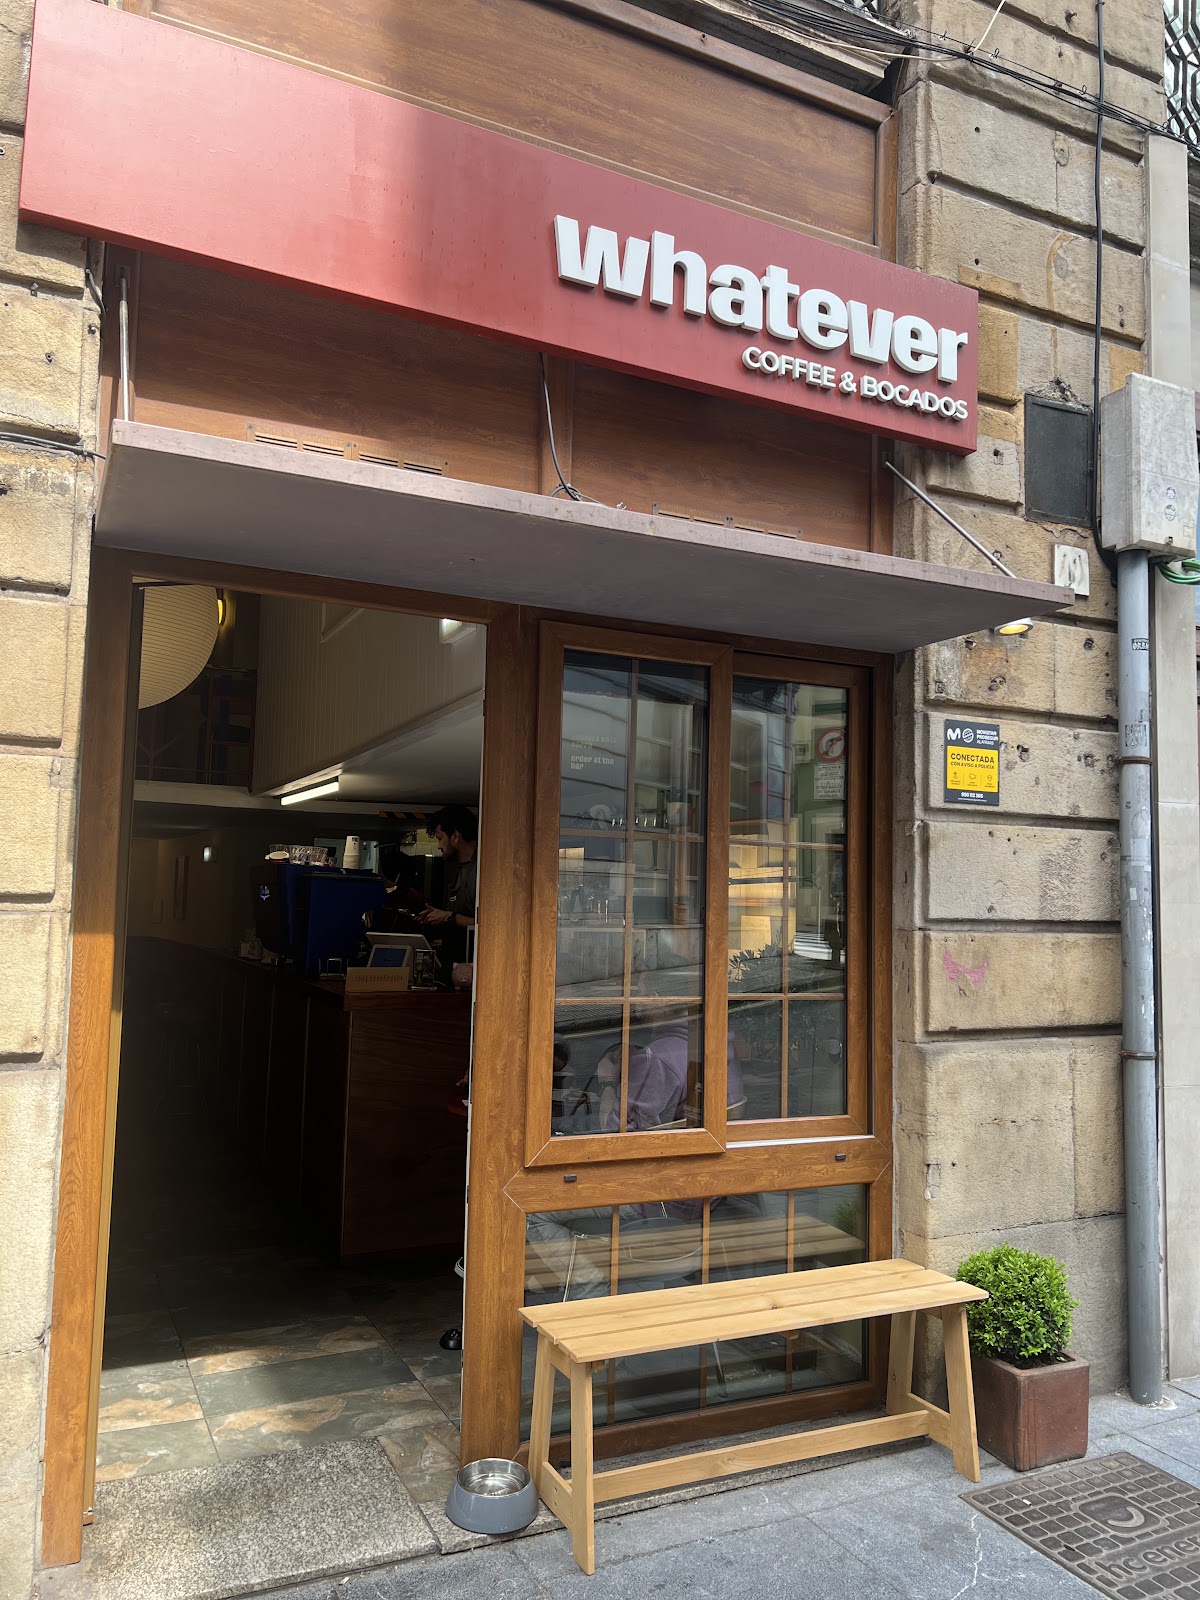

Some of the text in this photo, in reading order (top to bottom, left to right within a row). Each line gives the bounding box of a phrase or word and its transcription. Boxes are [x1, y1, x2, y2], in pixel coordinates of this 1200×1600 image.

[553, 214, 968, 383] whatever
[742, 346, 968, 421] COFFEE & BOCADOS
[571, 755, 592, 763] order
[602, 757, 614, 765] the
[951, 753, 995, 763] CONECTADA
[570, 762, 584, 770] bar
